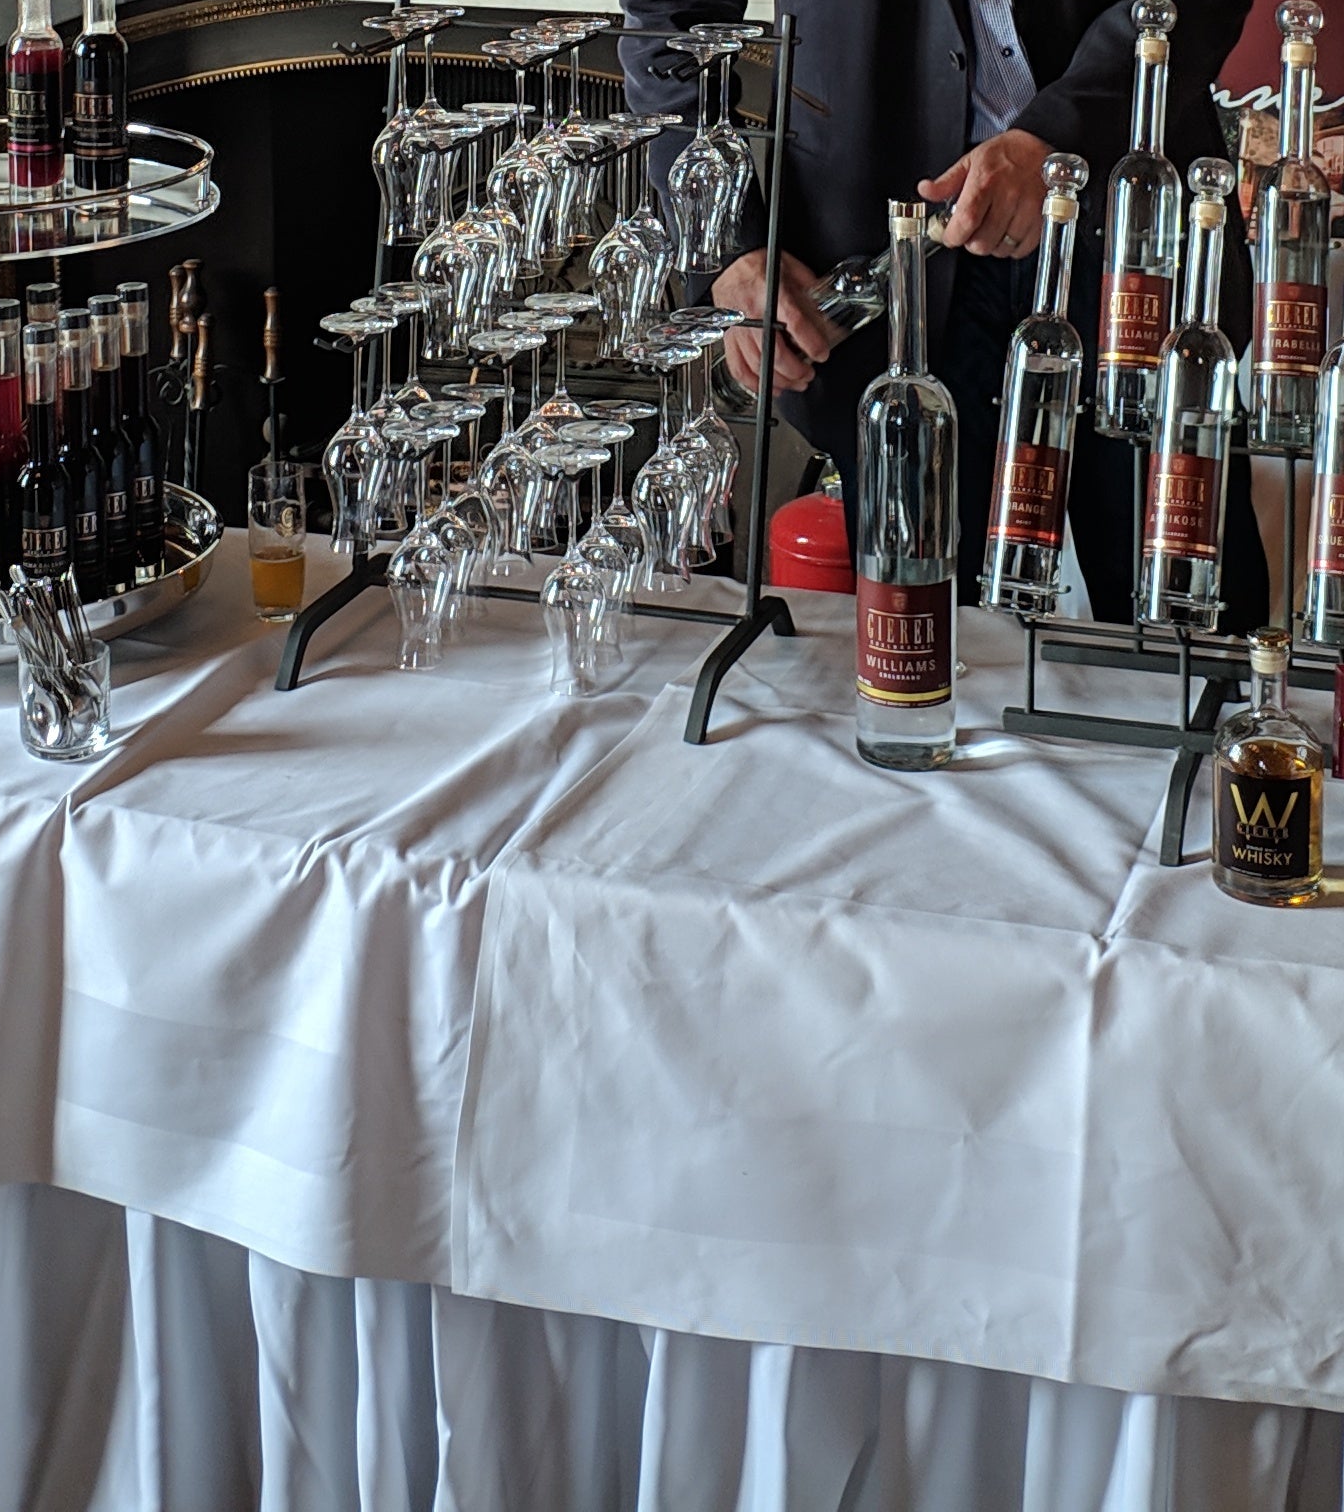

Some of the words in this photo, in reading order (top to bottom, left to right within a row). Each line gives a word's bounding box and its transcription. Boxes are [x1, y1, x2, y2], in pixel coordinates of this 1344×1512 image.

[1150, 513, 1206, 528] ARIKOSE
[867, 612, 936, 645] GIERER
[865, 653, 937, 672] WILLIAMS
[1232, 844, 1293, 866] WHISKY
